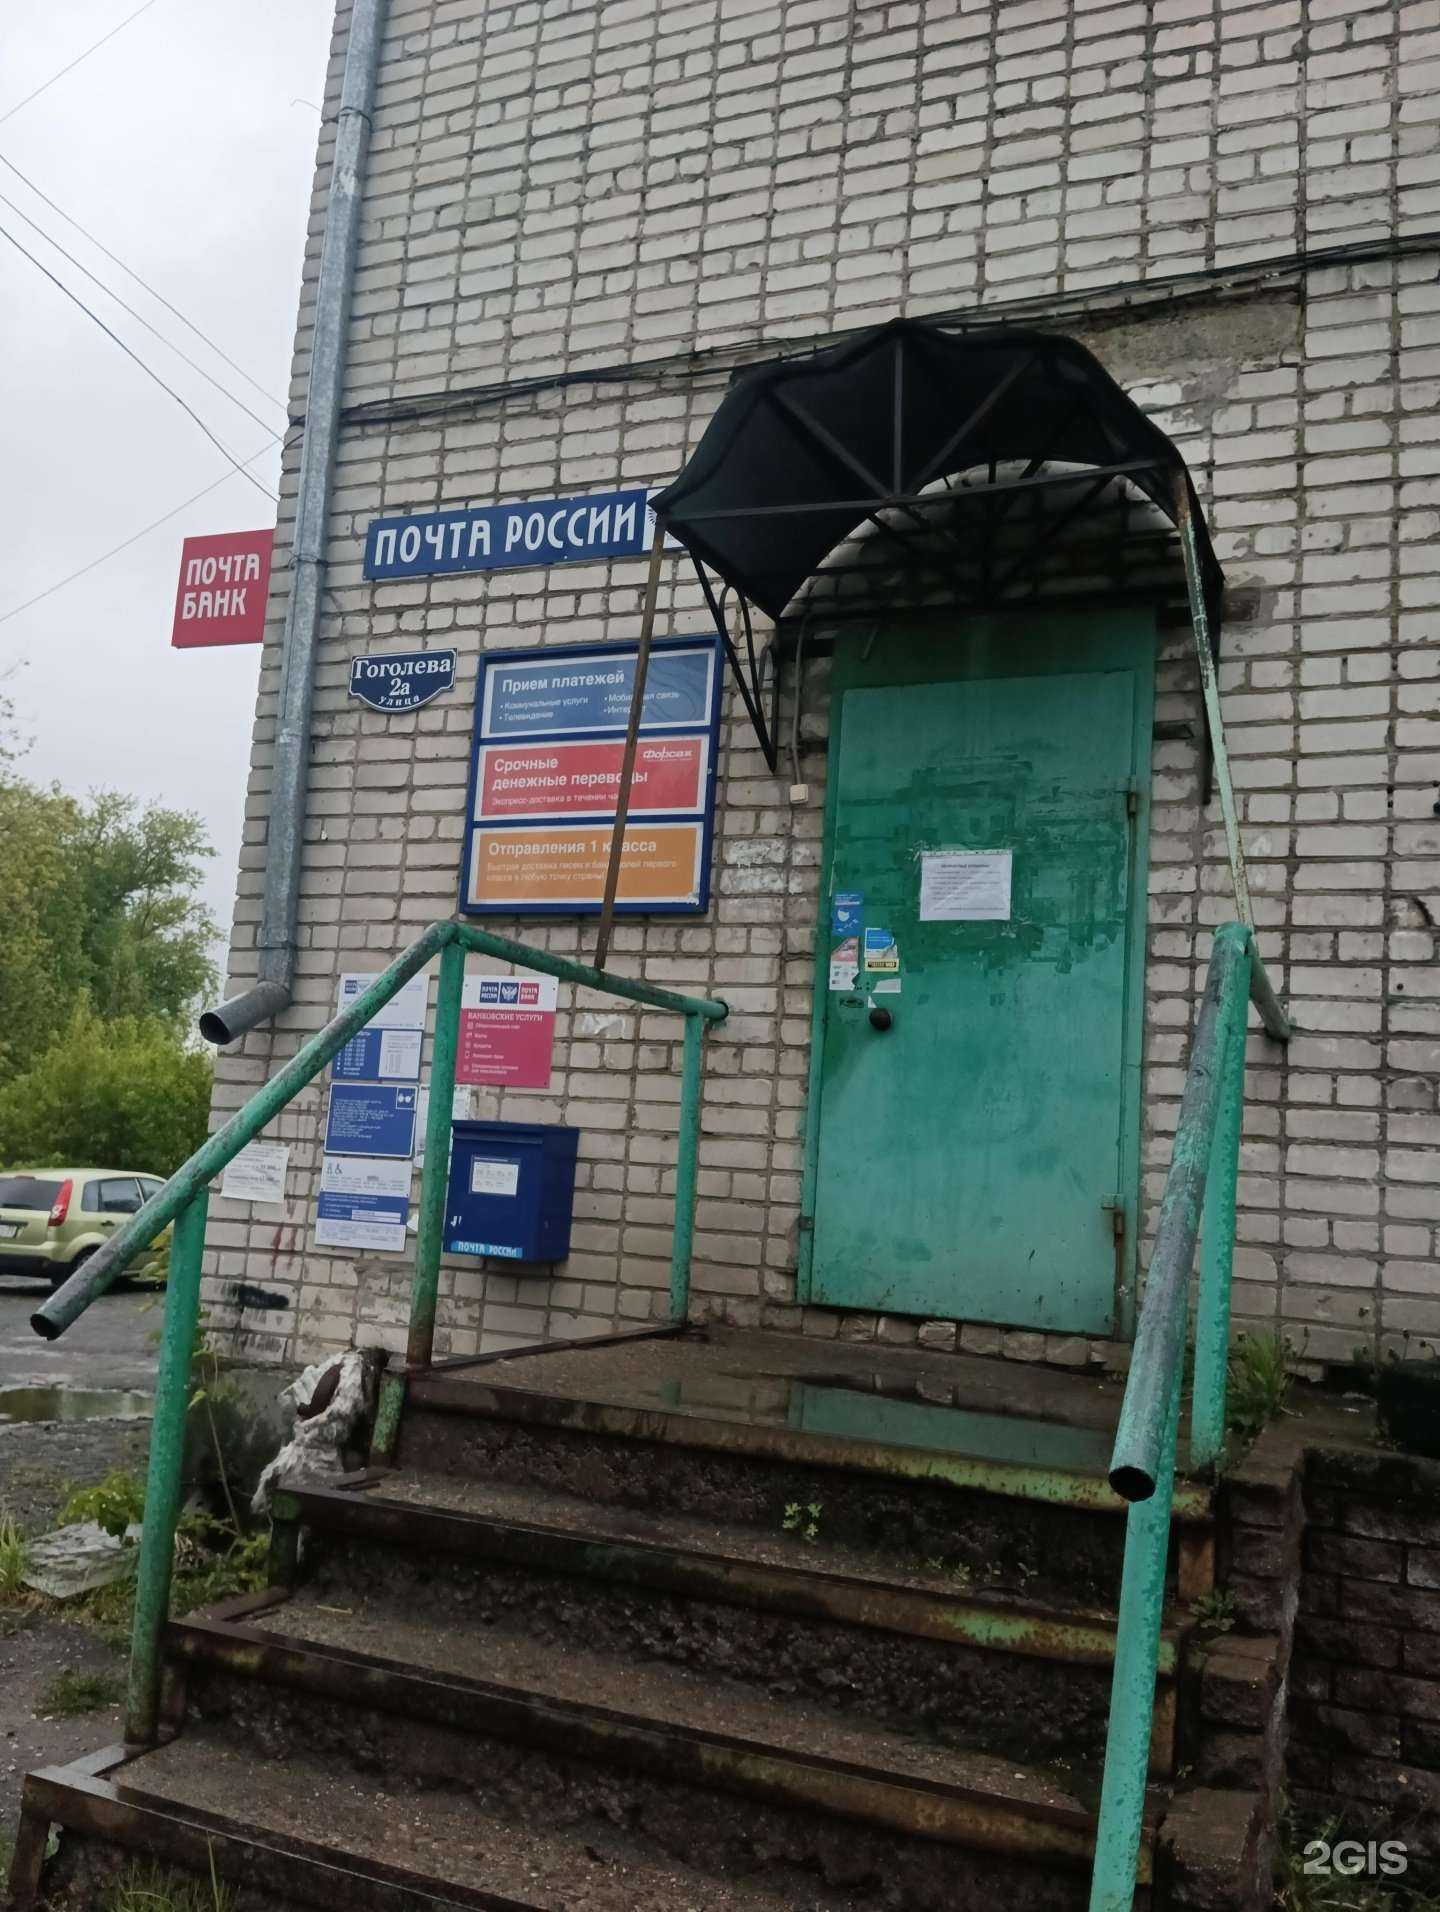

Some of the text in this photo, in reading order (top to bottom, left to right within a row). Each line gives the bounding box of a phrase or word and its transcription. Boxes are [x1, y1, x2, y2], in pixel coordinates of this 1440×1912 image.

[374, 502, 636, 566] ПОЧТА РОССИИ
[185, 553, 260, 586] ПОЧТА
[182, 588, 248, 620] БАНК
[354, 657, 451, 679] Гоголева
[388, 679, 410, 696] 2а
[502, 670, 625, 694] Прием платежей
[378, 694, 421, 706] улица
[562, 696, 589, 707] услуги
[494, 757, 559, 775] Срочные
[492, 774, 567, 791] денежные
[489, 839, 657, 858] Отправления 1 касса
[458, 1241, 517, 1257] ПОЧТА РОССИИ
